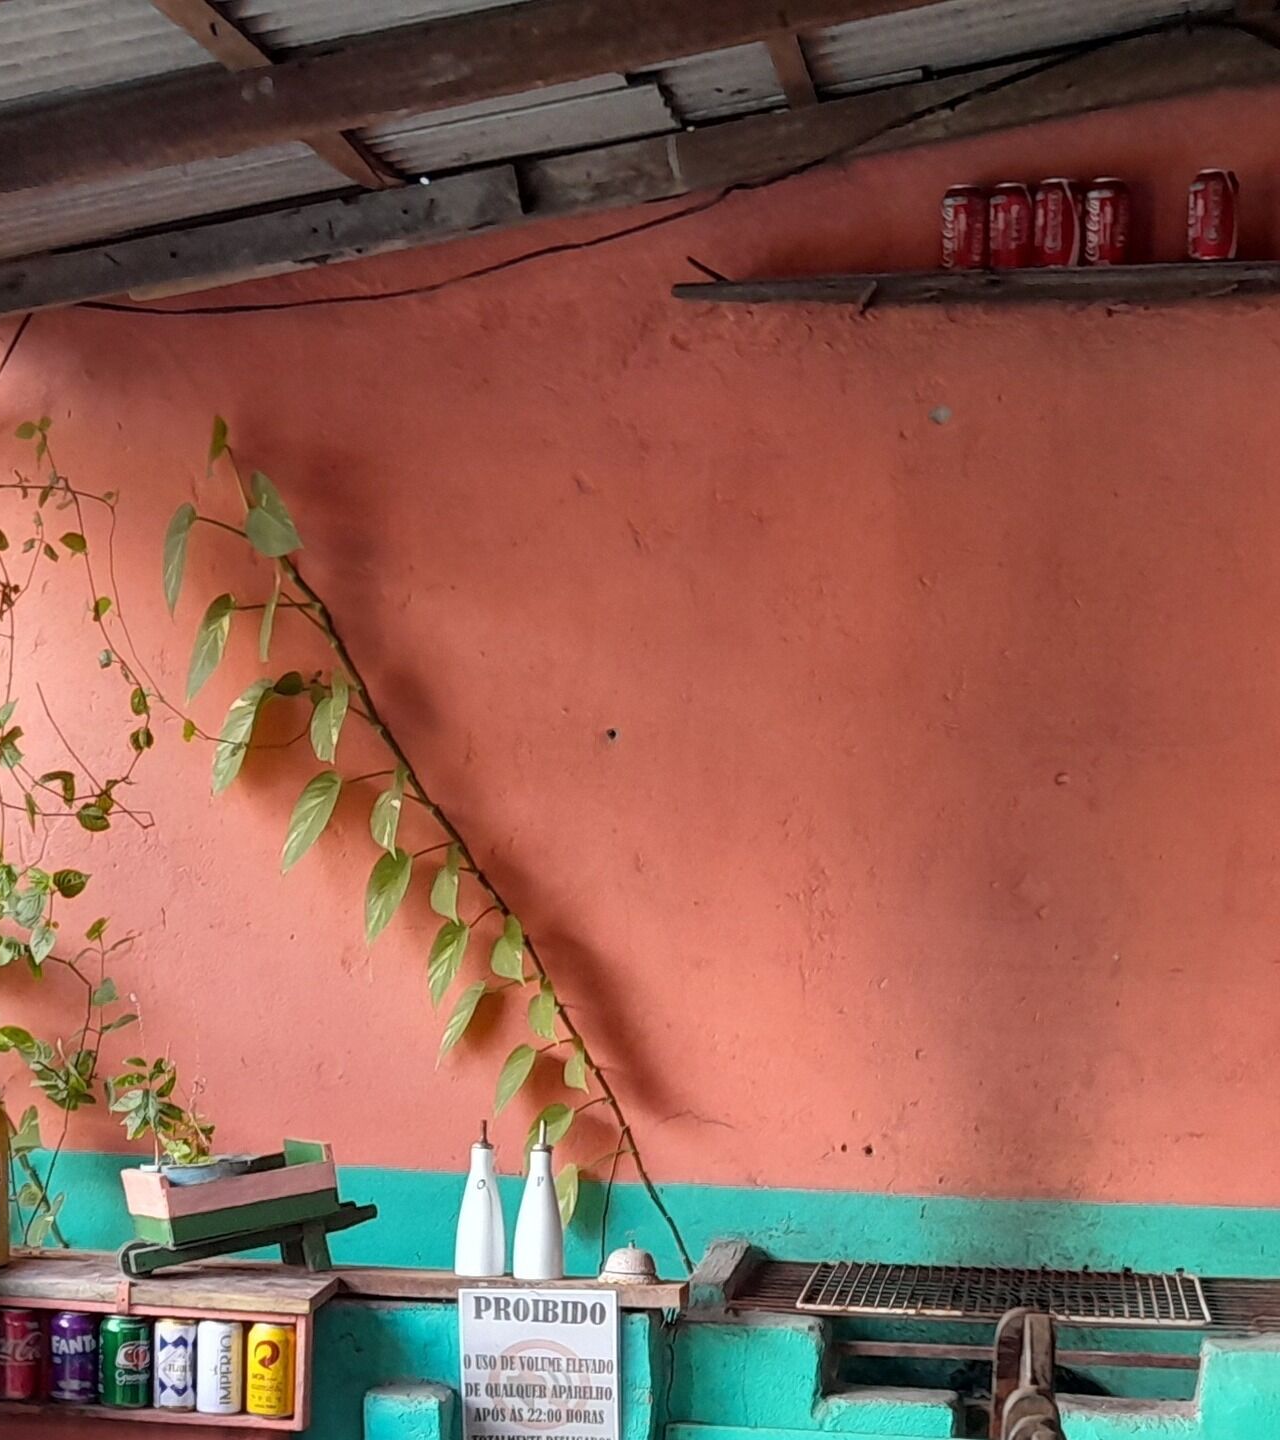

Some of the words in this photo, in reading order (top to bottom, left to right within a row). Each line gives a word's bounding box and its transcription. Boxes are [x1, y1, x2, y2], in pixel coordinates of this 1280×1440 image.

[473, 1296, 607, 1326] PROIBIDO
[464, 1354, 472, 1369] O
[476, 1354, 497, 1370] USO
[501, 1355, 517, 1371] DE
[519, 1356, 562, 1373] VOLUME
[566, 1359, 614, 1375] ELEVADO
[465, 1383, 481, 1398] DE
[485, 1383, 547, 1399] QUALQUER
[527, 1408, 562, 1423] 22:00
[566, 1409, 605, 1424] HORAS
